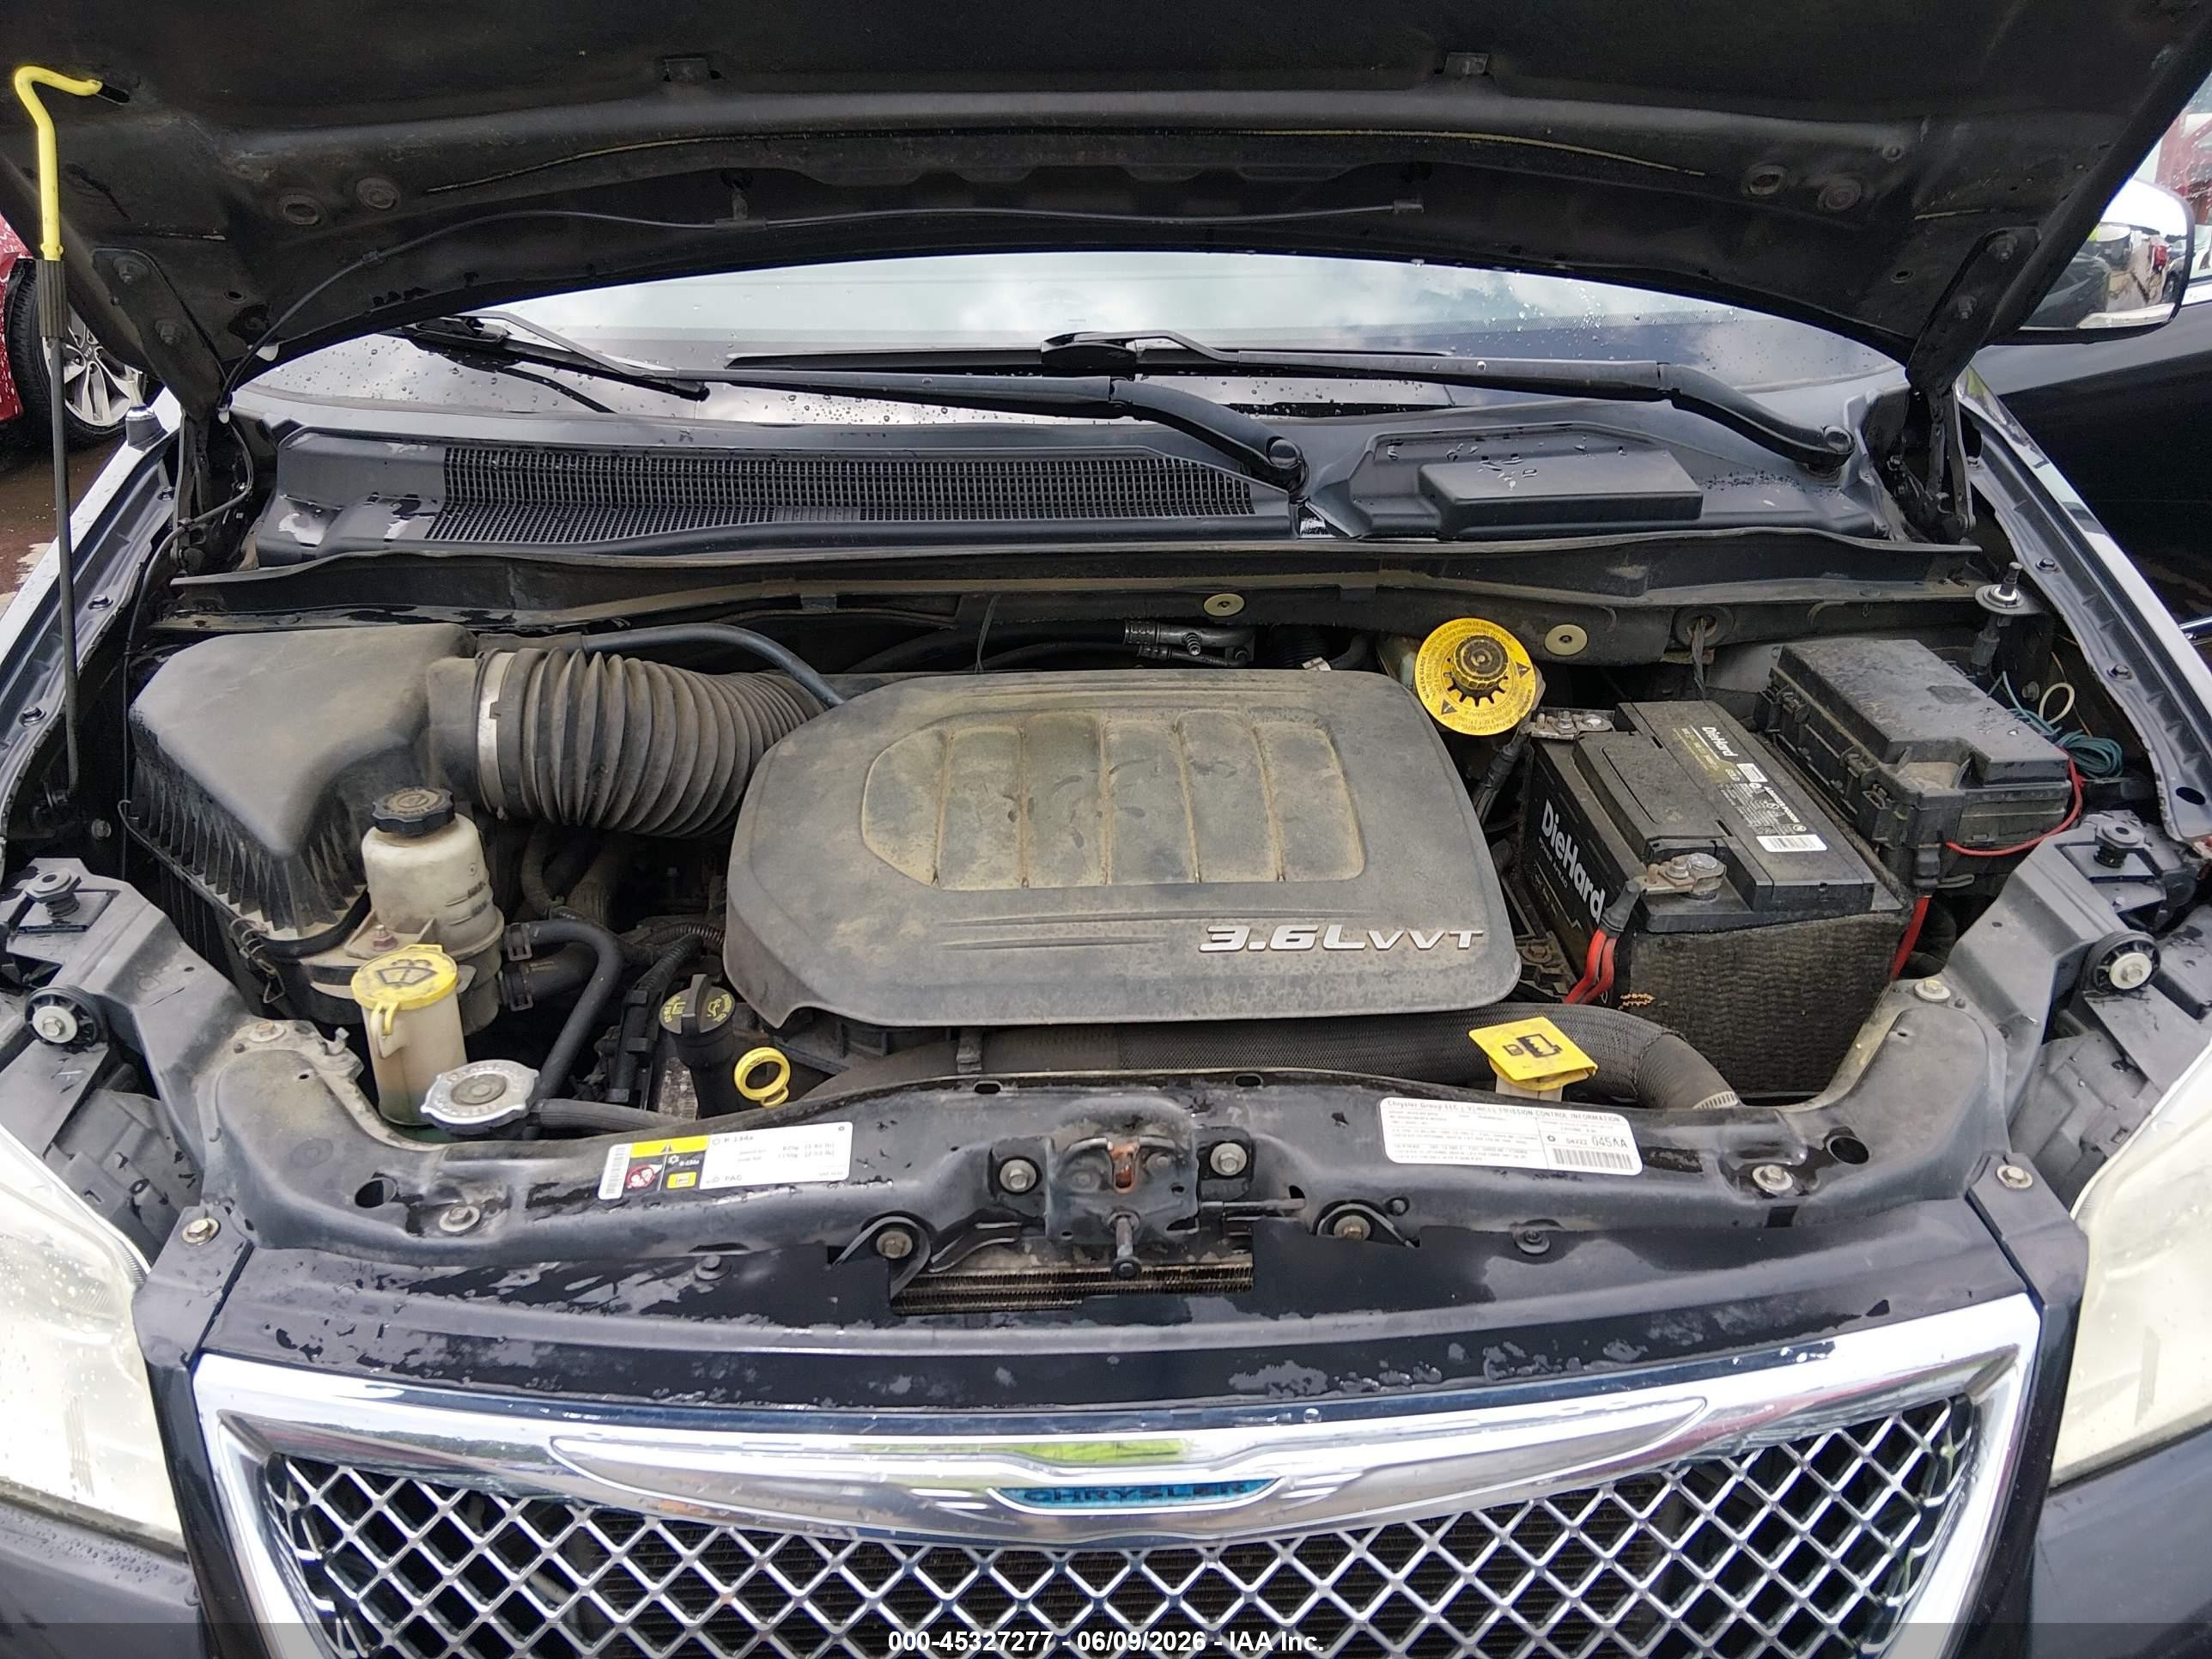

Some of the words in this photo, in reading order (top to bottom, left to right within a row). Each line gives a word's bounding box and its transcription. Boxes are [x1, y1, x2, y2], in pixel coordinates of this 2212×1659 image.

[1702, 726, 1739, 757] DieHard
[1541, 799, 1606, 926] DieHard
[1420, 1103, 1443, 1111] Group
[1535, 1110, 1568, 1119] CONTROL
[1571, 1113, 1621, 1122] INFORMATION
[1024, 1482, 1246, 1502] CHRYSLER
